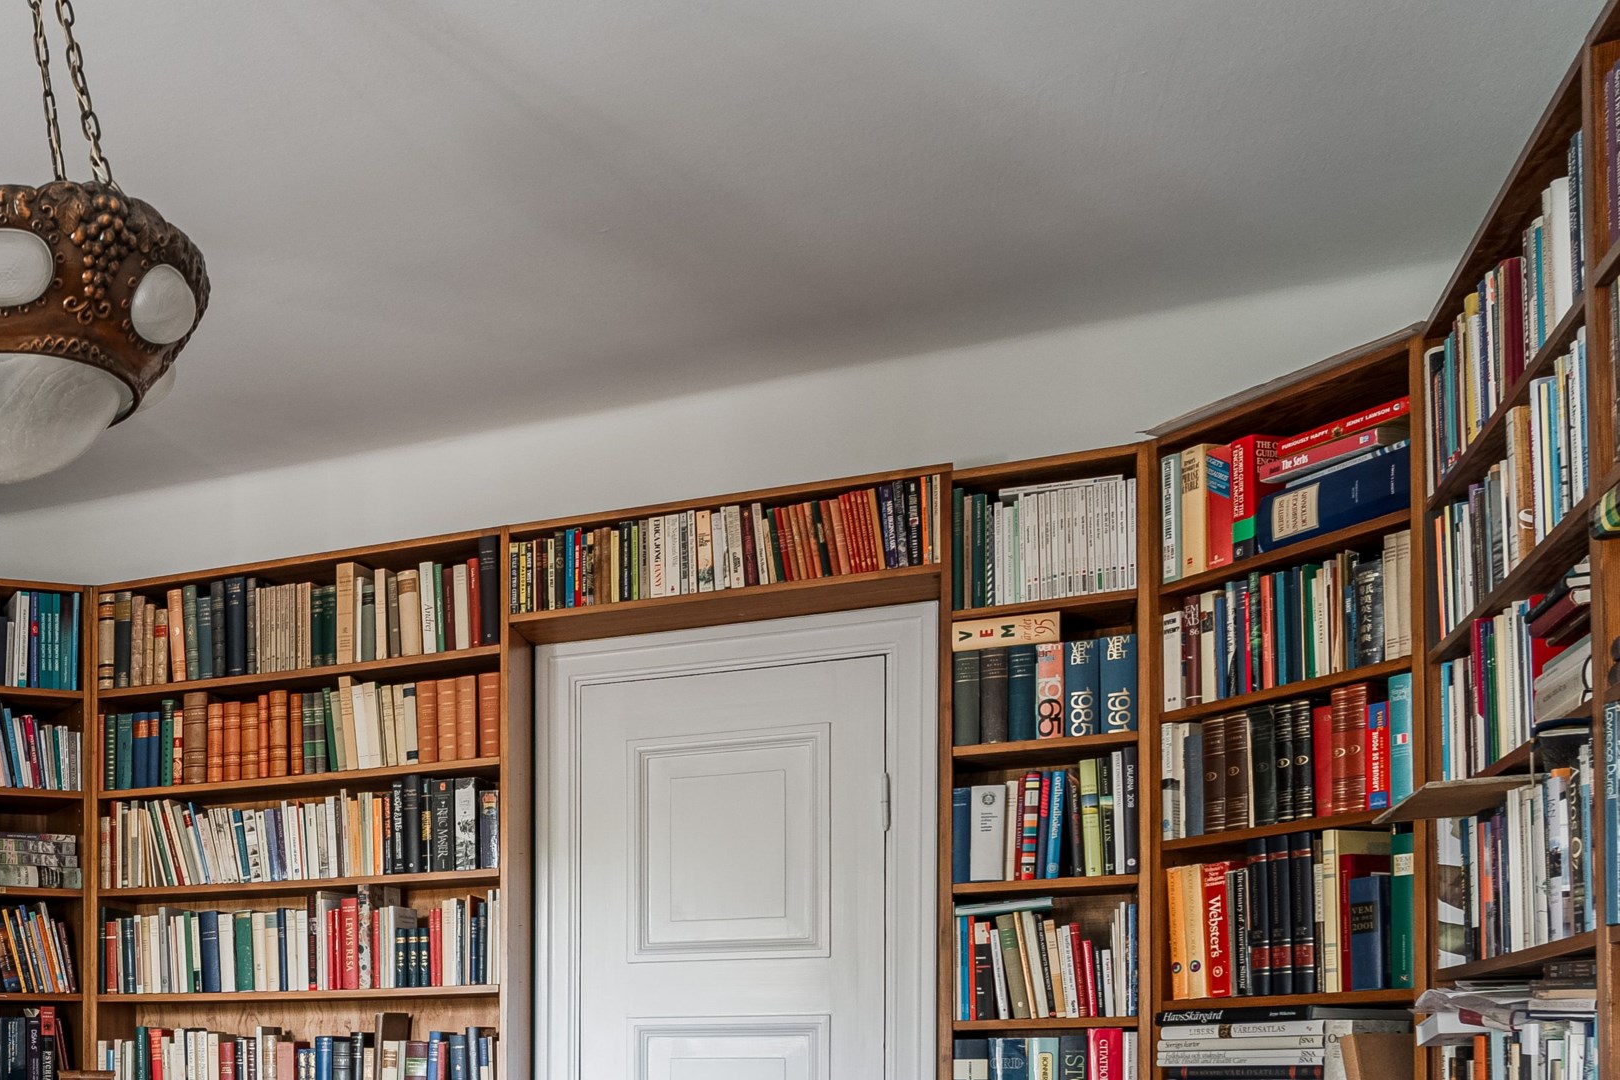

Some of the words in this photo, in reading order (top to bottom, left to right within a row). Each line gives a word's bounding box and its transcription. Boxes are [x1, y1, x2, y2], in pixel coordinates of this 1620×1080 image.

[1281, 435, 1310, 451] FURIOUSLY
[1310, 429, 1329, 441] HAPPY
[1345, 416, 1365, 428] JENNY
[1365, 407, 1391, 421] LAWSON
[1256, 440, 1272, 449] THE
[1282, 458, 1293, 470] The
[1293, 454, 1309, 466] Serbs
[654, 564, 662, 588] FANNY
[424, 603, 434, 632] Andrej
[958, 624, 1015, 642] VEM
[1070, 641, 1094, 649] VEM
[1107, 636, 1131, 644] VEM
[1071, 655, 1091, 665] DET
[1107, 650, 1128, 661] DET
[1038, 674, 1063, 737] 1965
[1070, 686, 1093, 737] 1985
[1107, 687, 1131, 734] 1991
[1371, 731, 1379, 751] POCHE
[1606, 706, 1616, 762] Lawrence
[1372, 753, 1379, 761] DE
[1372, 762, 1380, 792] LAROUSSE
[1606, 763, 1617, 800] Durrell
[1051, 776, 1062, 839] ordhandboken
[1569, 766, 1580, 830] Amos
[436, 829, 449, 859] MASTER
[1571, 837, 1583, 869] Oz
[1237, 872, 1246, 912] Dictionary
[1238, 914, 1245, 922] of
[1351, 905, 1373, 914] VEM
[345, 917, 354, 946] LEWIS
[1207, 894, 1223, 958] Webster's
[1351, 921, 1373, 931] 2001
[1238, 925, 1246, 963] American
[345, 948, 355, 972] RESA
[1162, 1010, 1224, 1023] HavsSkärgård
[30, 1029, 38, 1050] DSM-5
[1188, 1027, 1215, 1036] LIBERS
[1232, 1024, 1286, 1034] VÄRLDSATLAS
